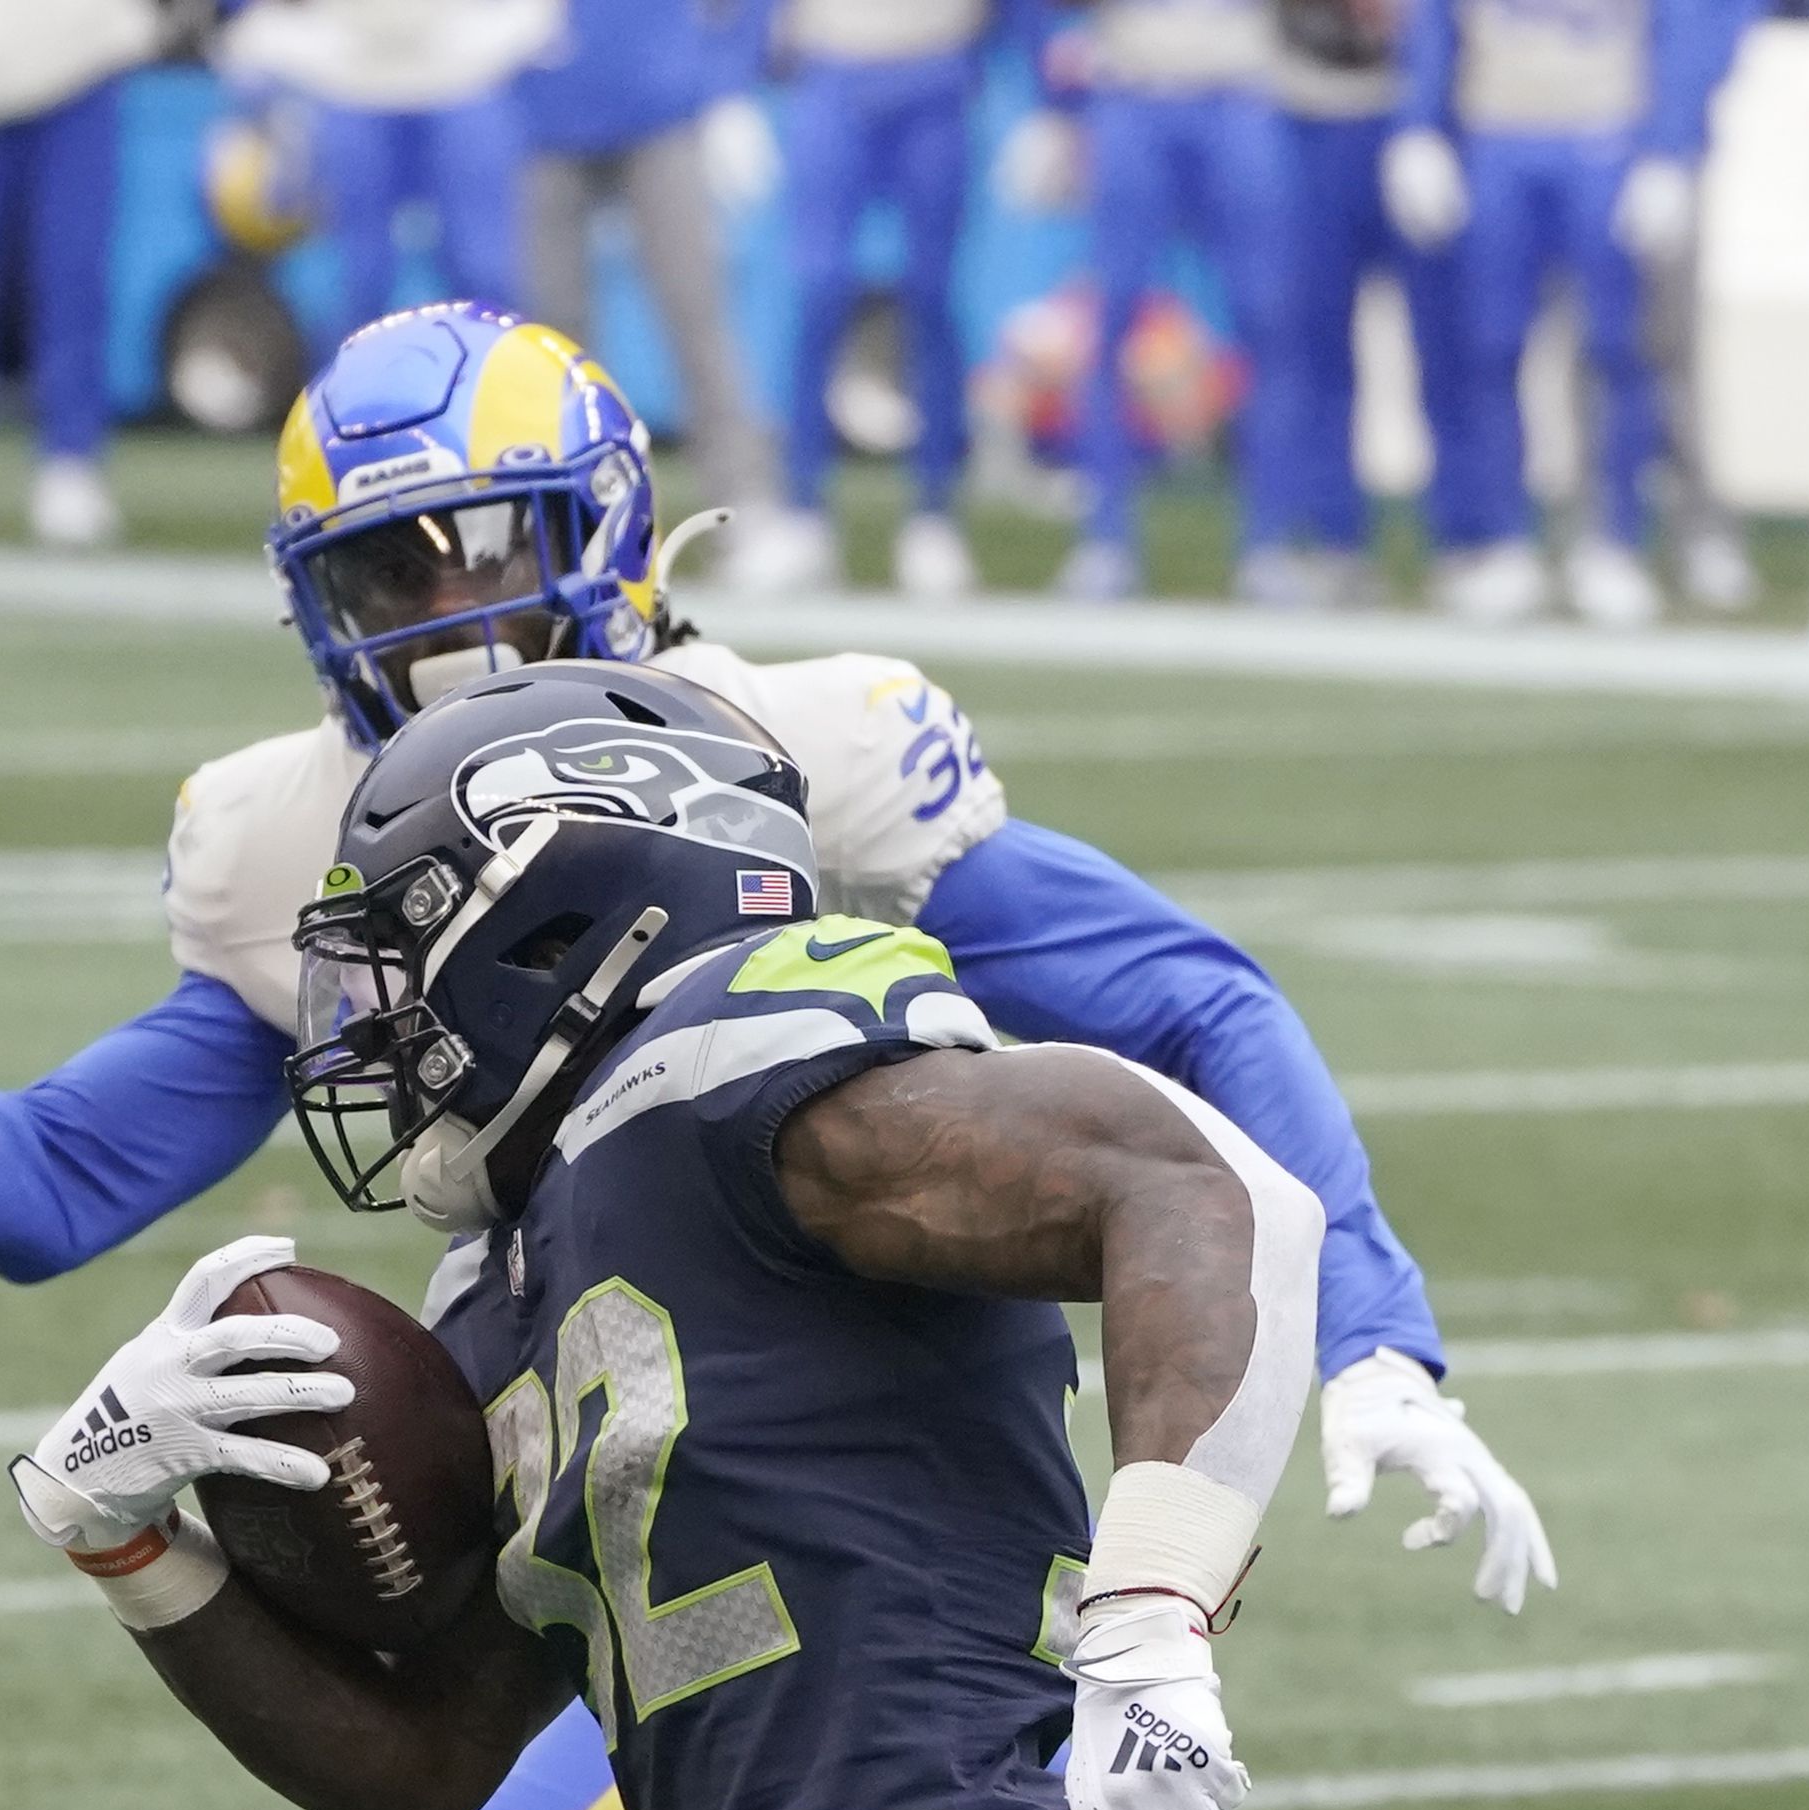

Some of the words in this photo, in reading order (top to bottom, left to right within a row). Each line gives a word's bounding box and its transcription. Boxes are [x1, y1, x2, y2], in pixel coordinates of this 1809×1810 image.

[585, 1062, 666, 1127] SEAHAWKS
[65, 1424, 152, 1473] adidas
[484, 1273, 802, 1755] 32
[1124, 1703, 1209, 1769] adidas
